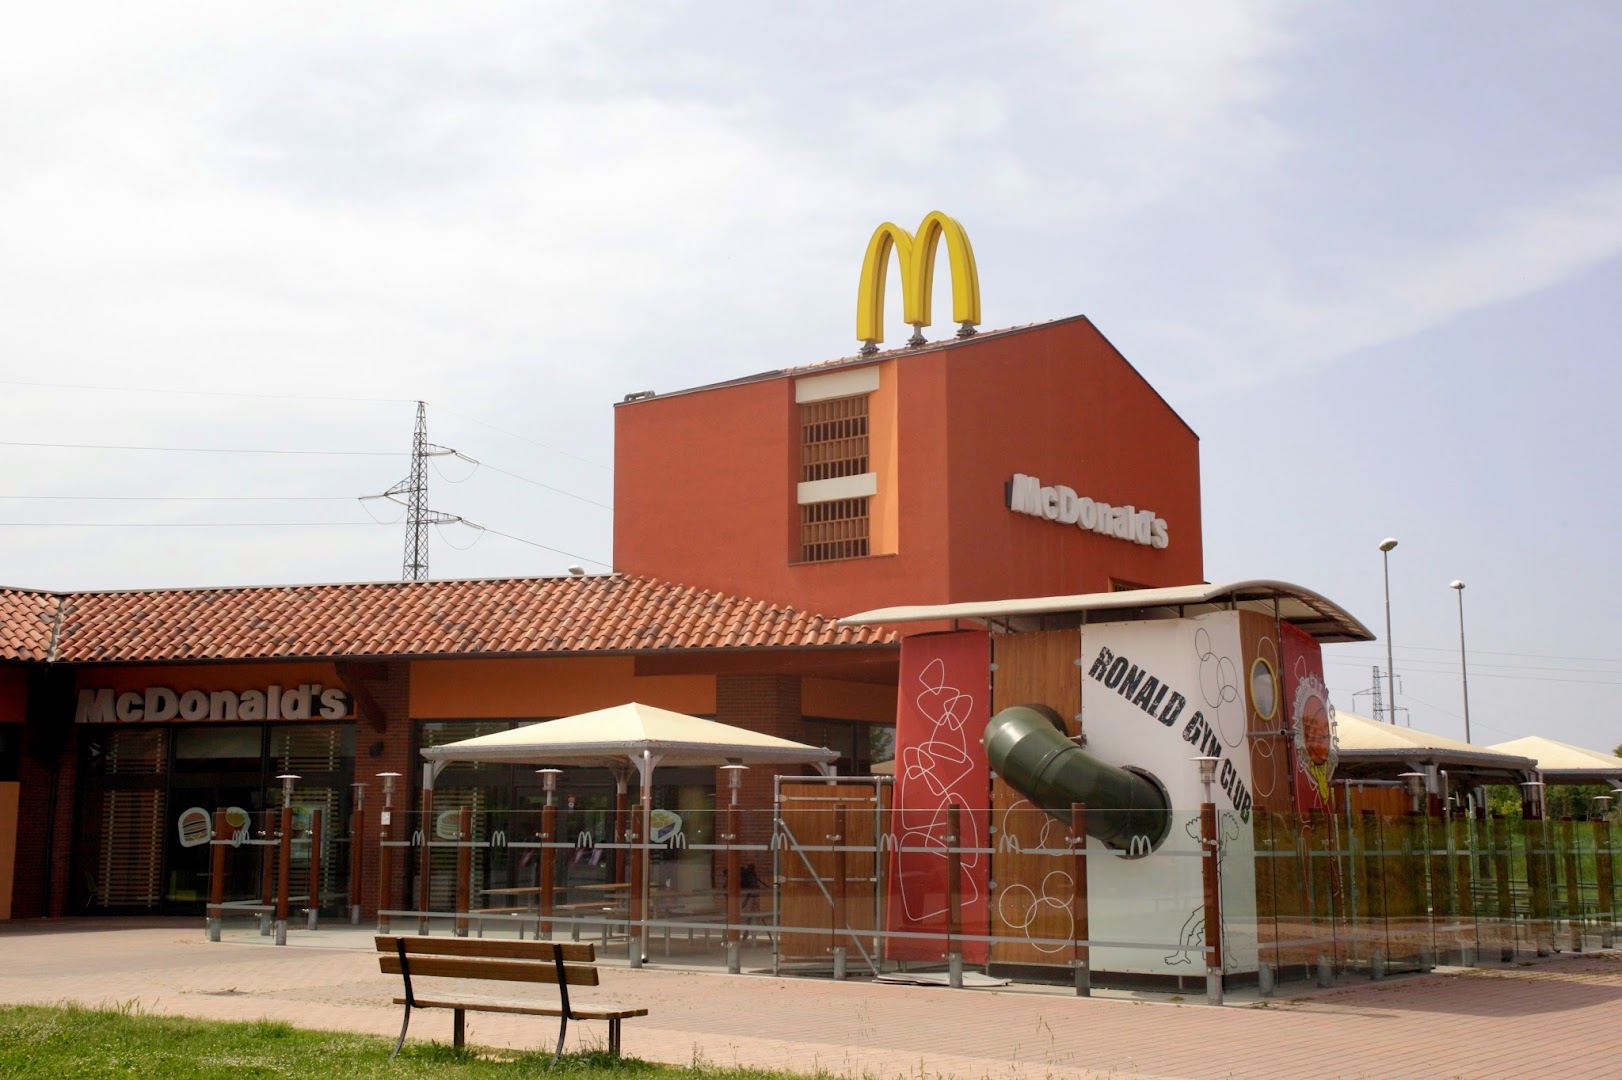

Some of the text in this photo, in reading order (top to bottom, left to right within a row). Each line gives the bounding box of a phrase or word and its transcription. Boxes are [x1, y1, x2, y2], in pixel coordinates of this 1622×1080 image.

[1010, 473, 1169, 549] McDonald's
[74, 685, 348, 723] McDonald's
[1088, 646, 1187, 728] RONALD
[1220, 758, 1252, 824] CLUB
